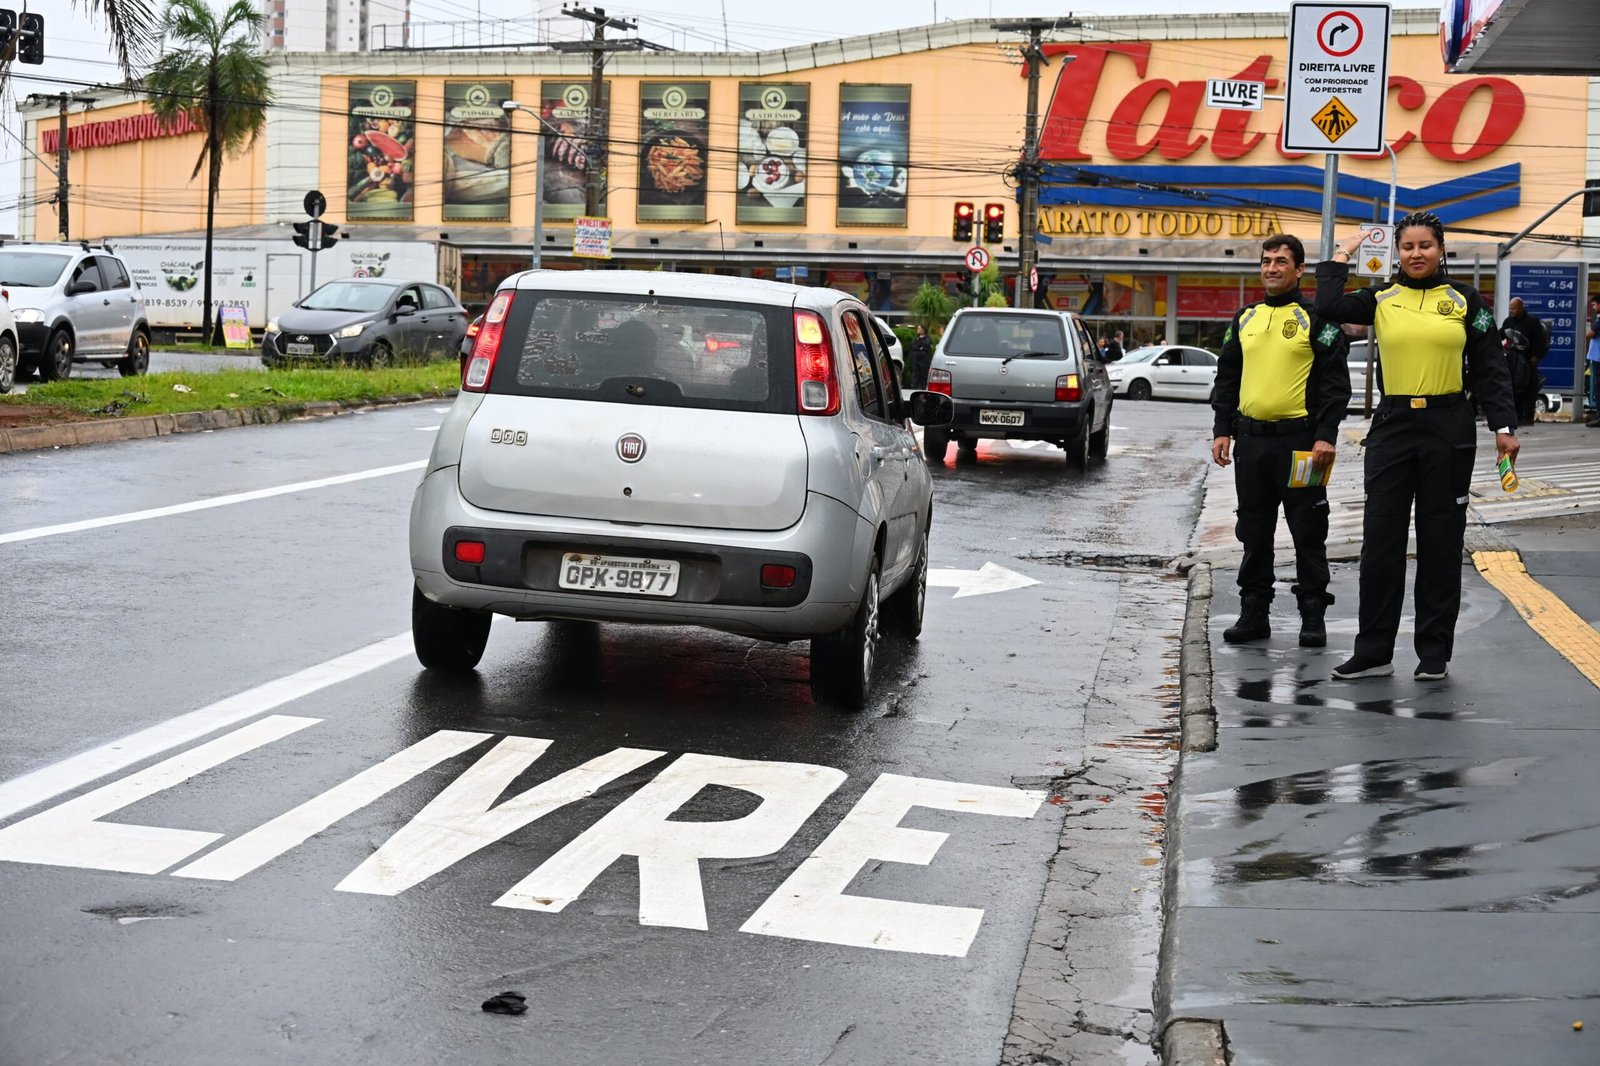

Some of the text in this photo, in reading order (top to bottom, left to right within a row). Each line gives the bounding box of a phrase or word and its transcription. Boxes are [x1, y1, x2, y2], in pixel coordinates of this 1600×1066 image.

[1299, 63, 1376, 73] DIREITA LIVRE
[1323, 78, 1369, 86] PRIORIDADE
[1211, 81, 1258, 99] LIVRE
[1021, 42, 1526, 163] Tatco
[841, 112, 852, 122] A
[871, 112, 882, 122] de
[882, 111, 905, 122] Deus
[1037, 210, 1284, 237] ARATO TODO DIA
[1549, 280, 1574, 290] 4.54
[144, 299, 187, 307] 819-8539
[1547, 299, 1572, 309] 6.44
[623, 440, 639, 455] FIAT
[0, 715, 1048, 957] LIVRE
